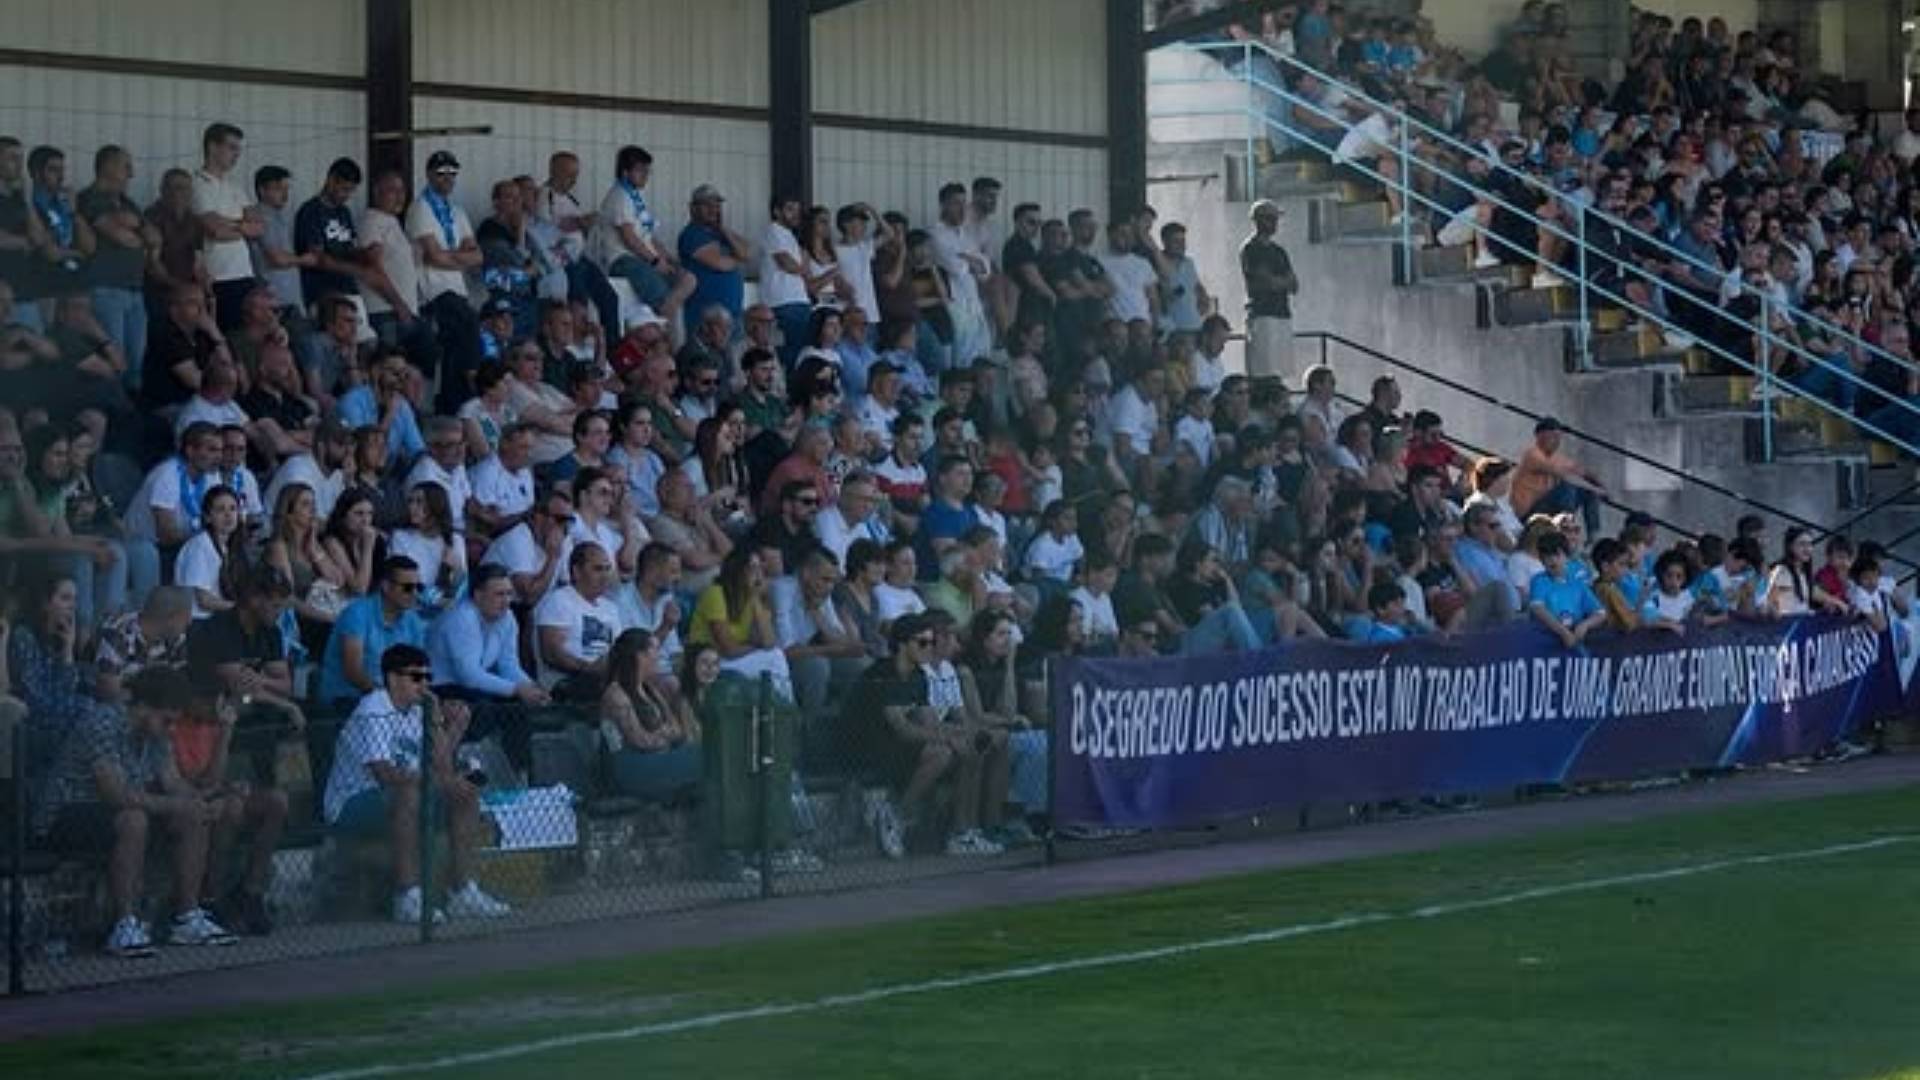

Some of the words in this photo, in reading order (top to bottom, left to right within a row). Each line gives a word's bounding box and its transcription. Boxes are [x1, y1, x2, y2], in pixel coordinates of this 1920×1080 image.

[1071, 682, 1087, 755] O
[1088, 686, 1192, 758] SEGREDO
[1194, 681, 1228, 752] DO
[1232, 669, 1333, 747] SUCESSO
[1337, 653, 1389, 738] ESTÁ
[1391, 664, 1422, 731] NO
[1424, 657, 1528, 731] TRABALHO
[1530, 657, 1561, 720] DE
[1562, 657, 1612, 719] UMA
[1613, 648, 1687, 716] GRANDE
[1745, 642, 1802, 713] FORÇA
